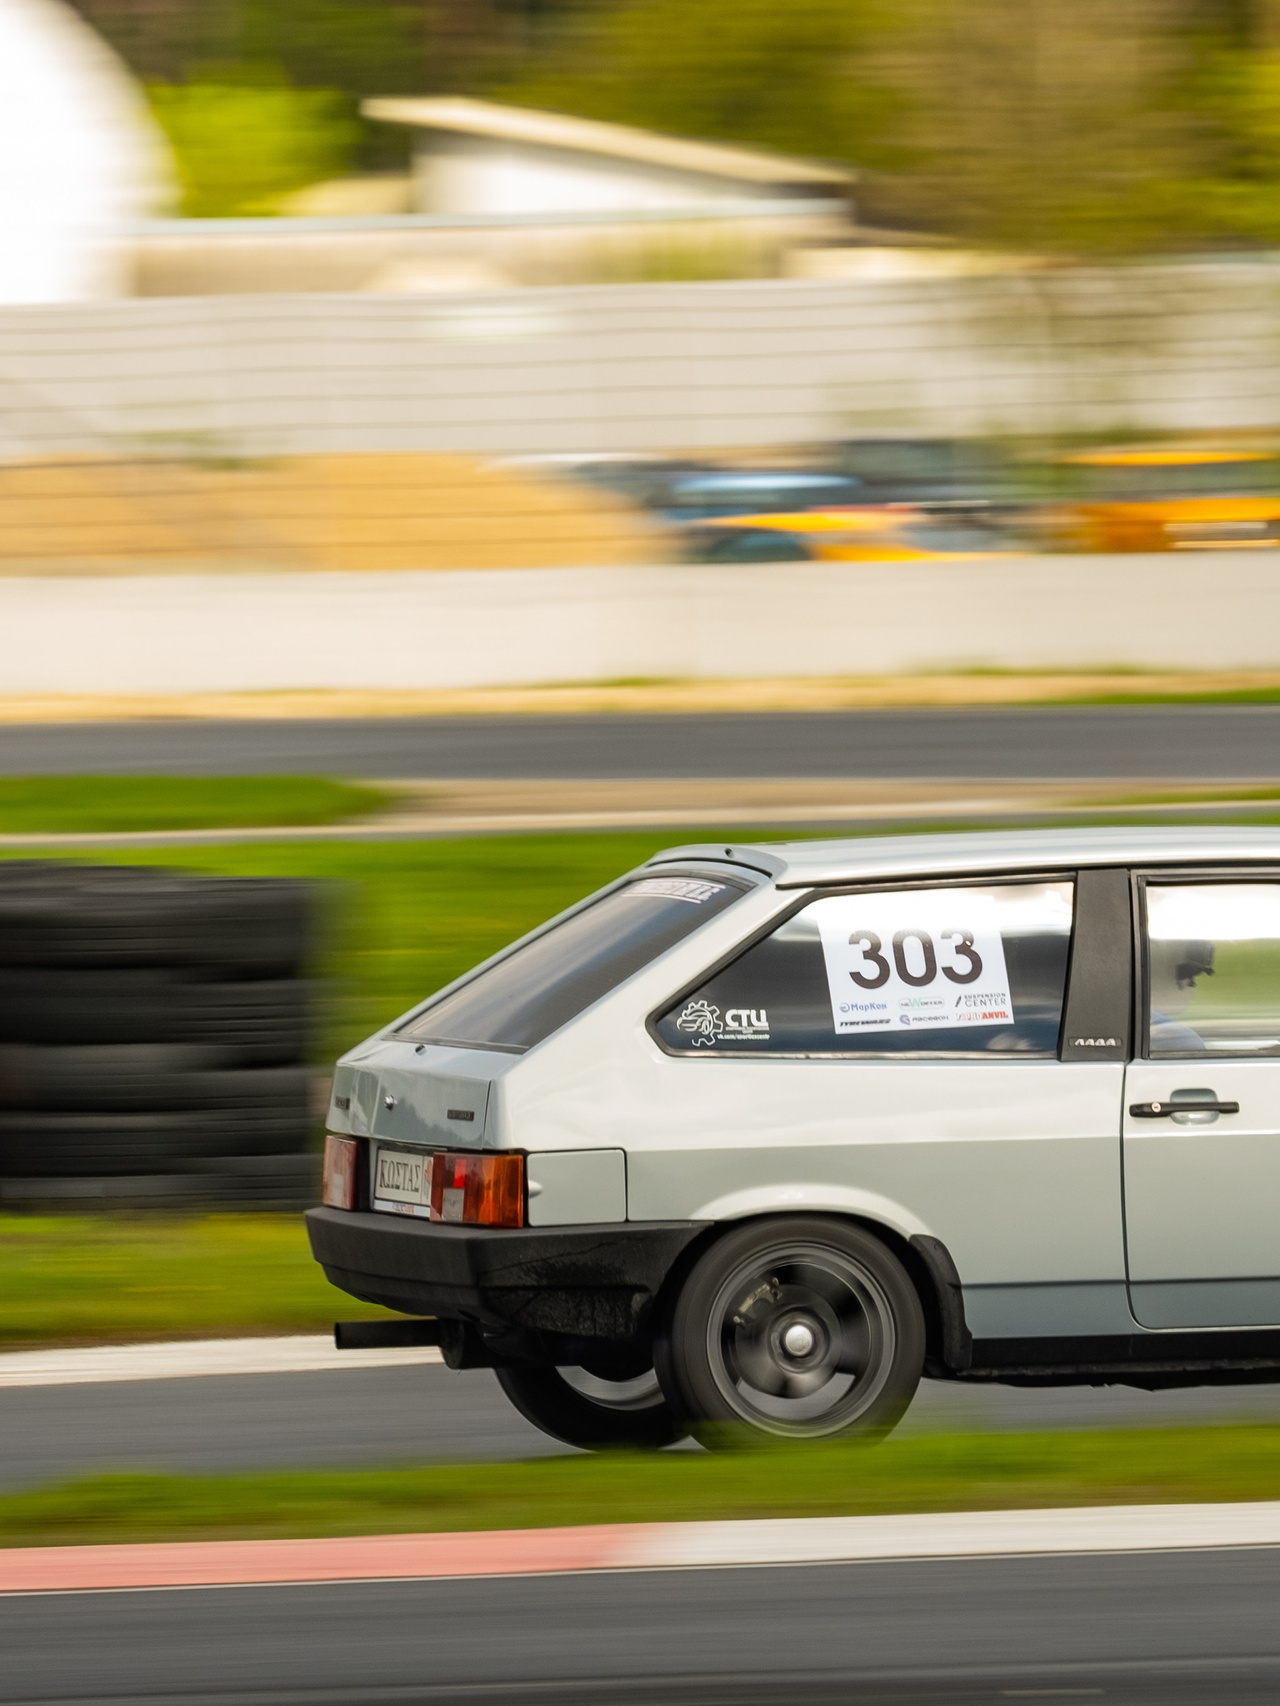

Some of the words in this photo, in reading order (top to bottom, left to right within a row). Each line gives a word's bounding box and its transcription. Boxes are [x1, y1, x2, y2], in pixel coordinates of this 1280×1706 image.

[848, 928, 983, 989] 303
[965, 998, 1006, 1007] CENTER
[725, 1009, 769, 1027] СТЦ
[379, 1159, 421, 1193] ΚΩΣΤΑΣ
